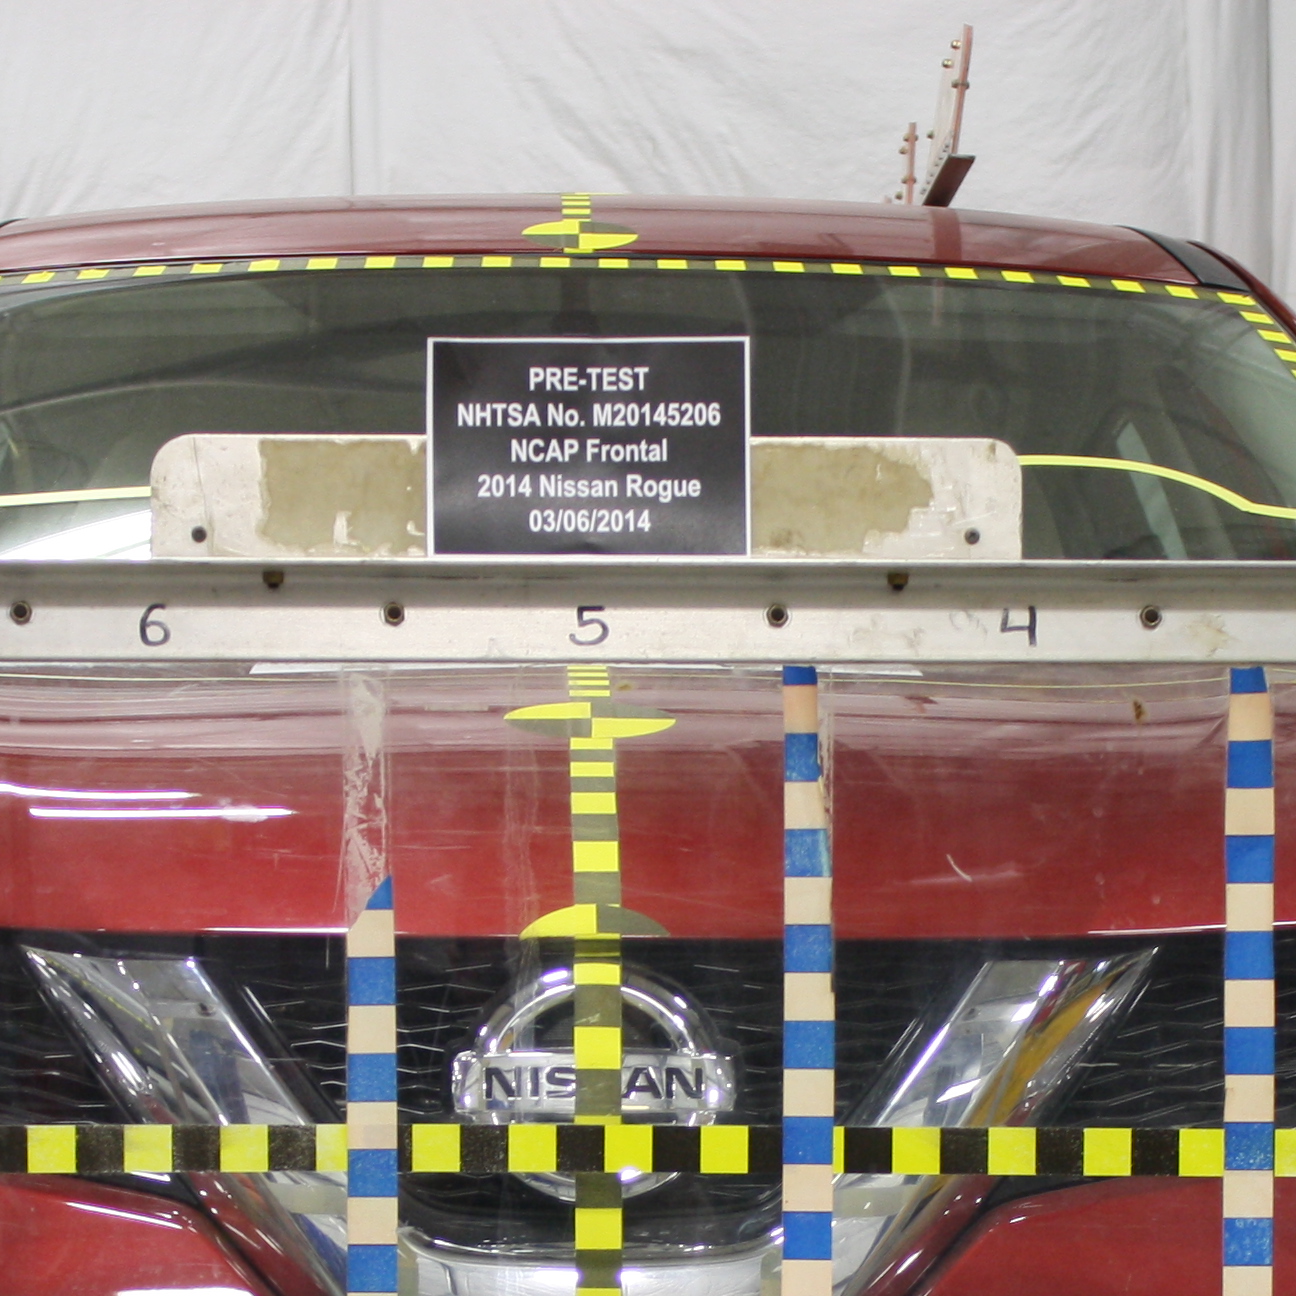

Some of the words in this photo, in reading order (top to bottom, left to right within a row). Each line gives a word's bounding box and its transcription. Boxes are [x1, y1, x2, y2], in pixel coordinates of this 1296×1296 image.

[530, 367, 649, 391] PRE-TEST
[458, 403, 541, 427] NHTSA
[548, 403, 585, 426] No.
[593, 403, 721, 426] M20145206
[511, 439, 579, 462] NCAP
[587, 438, 667, 462] Frontal
[477, 475, 532, 498] 2014
[539, 475, 618, 498] Nissan
[626, 474, 701, 503] Rogue
[529, 509, 651, 532] 03/06/2014
[139, 602, 171, 647] 6
[568, 606, 609, 646] 5
[999, 606, 1037, 647] 4
[483, 1065, 705, 1101] NISAN
